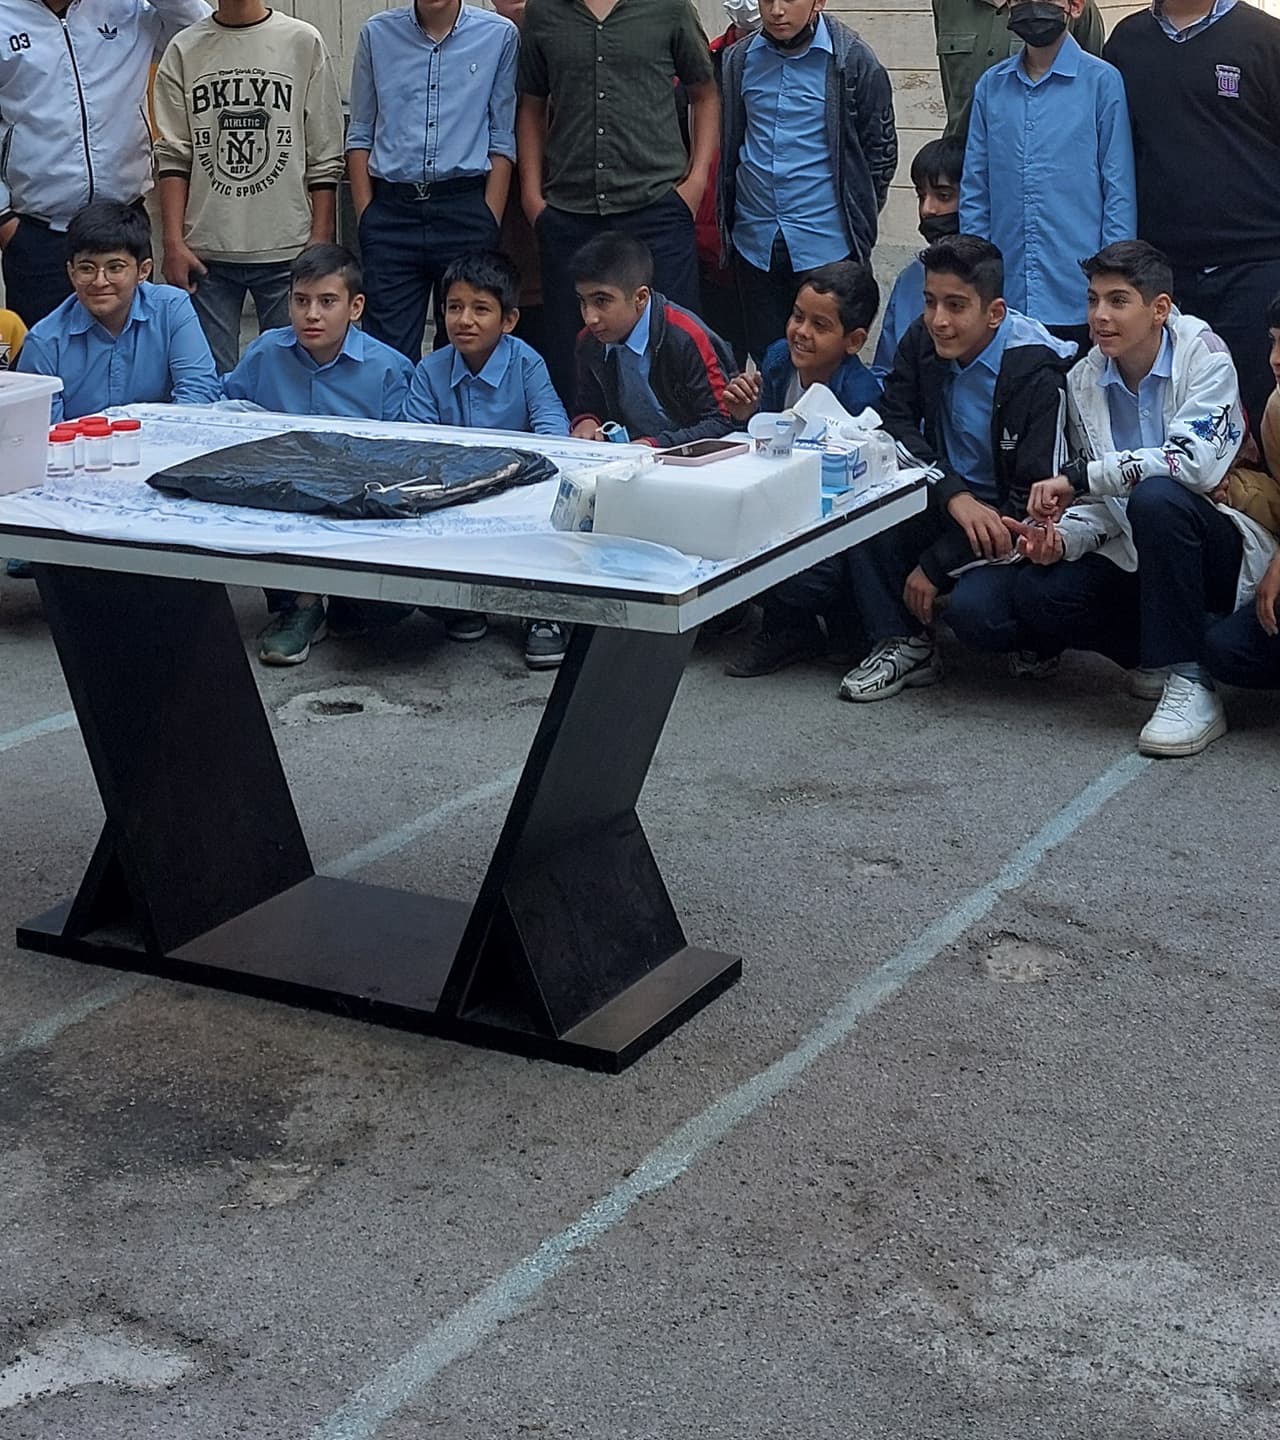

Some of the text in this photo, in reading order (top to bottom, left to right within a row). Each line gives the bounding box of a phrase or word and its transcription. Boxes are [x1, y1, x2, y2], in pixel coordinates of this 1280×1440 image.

[9, 33, 31, 52] 03
[192, 78, 292, 114] BKLYN
[223, 119, 261, 128] ATHLETIC
[195, 130, 292, 145] 19 73
[236, 151, 290, 197] SPORTSWEAR
